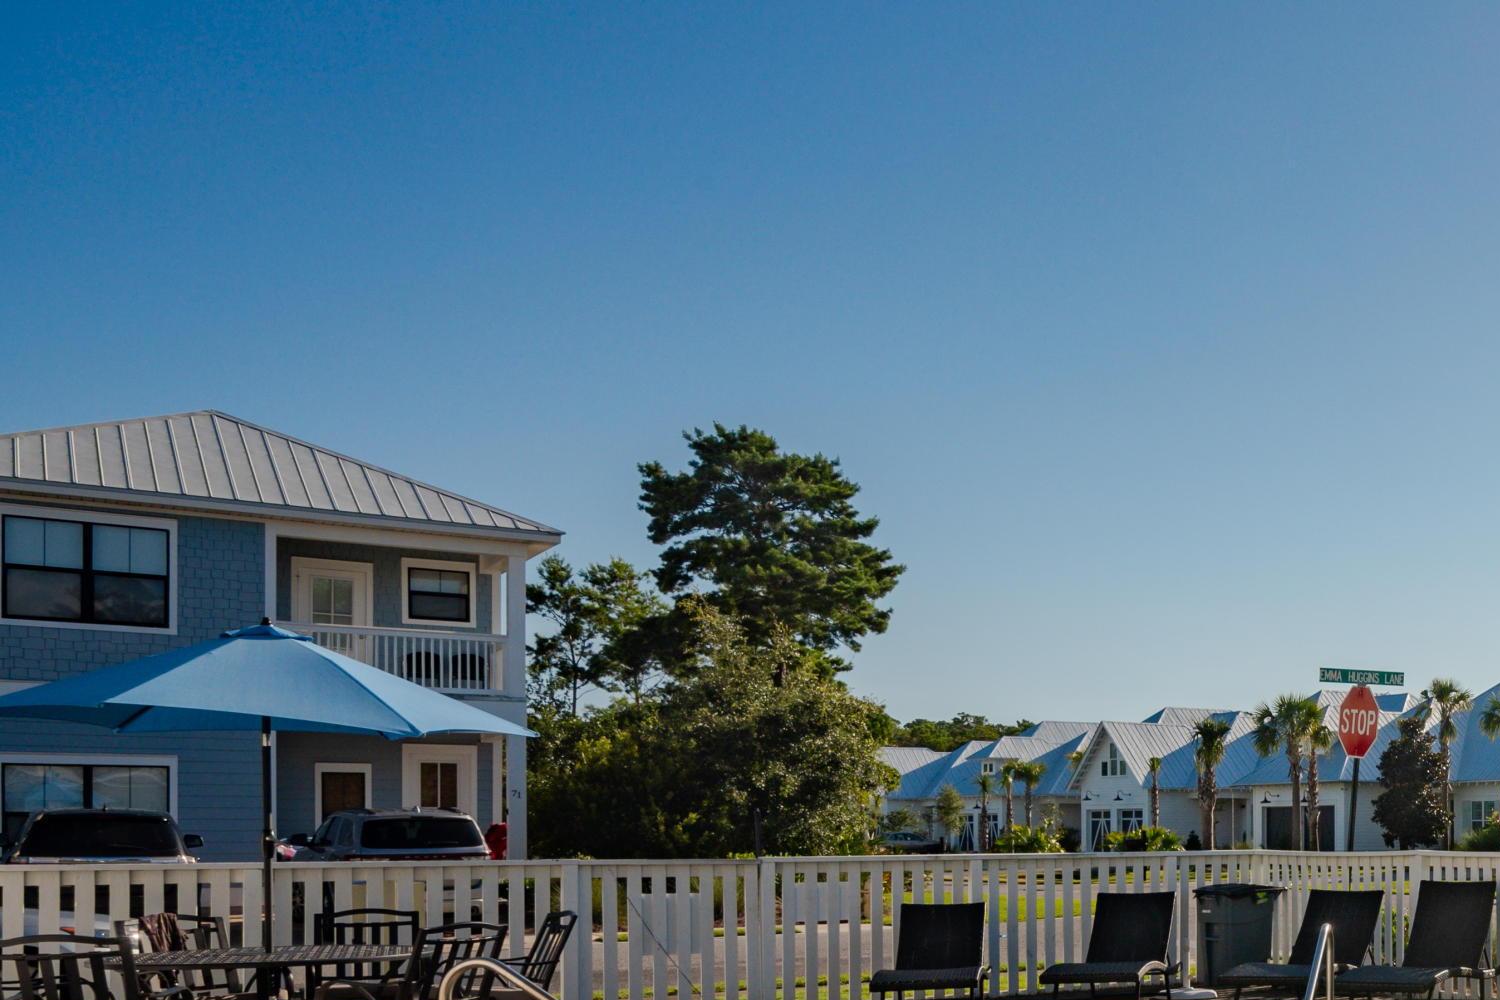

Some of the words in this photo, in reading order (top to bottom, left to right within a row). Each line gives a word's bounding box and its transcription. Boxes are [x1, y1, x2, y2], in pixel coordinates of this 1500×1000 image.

[1319, 669, 1342, 682] EMMA
[1348, 671, 1380, 684] HUGGINS
[1384, 673, 1404, 685] LANE
[1341, 708, 1376, 736] STOP
